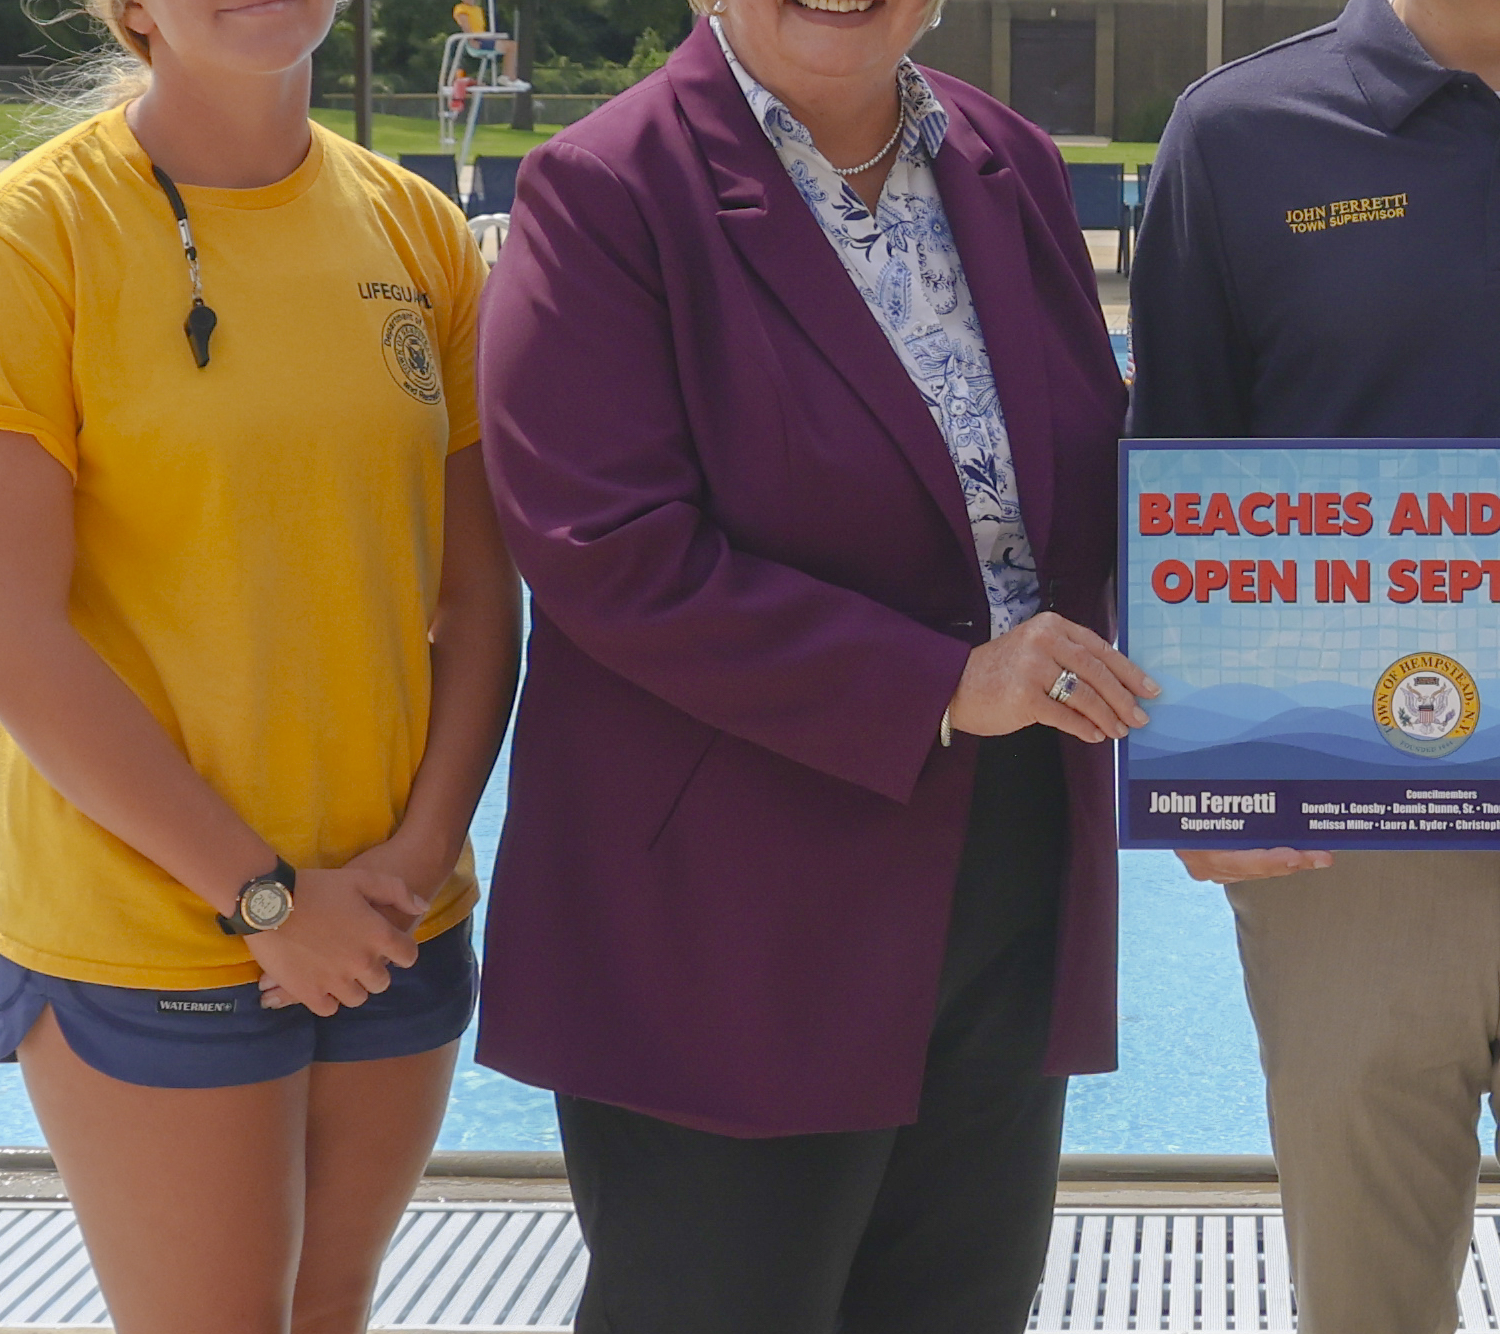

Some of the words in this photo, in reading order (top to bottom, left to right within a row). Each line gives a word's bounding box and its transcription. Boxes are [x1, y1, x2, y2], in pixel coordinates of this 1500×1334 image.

[1285, 205, 1326, 223] JOHN
[1329, 192, 1408, 216] FERRETTI
[1289, 219, 1326, 234] TOWN
[1329, 207, 1405, 227] SUPERVISOR
[1138, 492, 1373, 537] BEACHES
[1151, 560, 1298, 604] OPEN
[1314, 560, 1371, 604] IN
[1382, 670, 1398, 689] OF
[1377, 692, 1394, 735] TOWN
[1149, 791, 1197, 813] John
[1200, 791, 1276, 813] Ferretti
[1406, 789, 1478, 799] Councilmembers
[1301, 802, 1340, 815] Dorothy
[1341, 803, 1349, 814] L.
[1350, 802, 1386, 815] Goosby
[1392, 802, 1427, 814] Dennis
[1428, 803, 1461, 815] Dunne,
[1462, 803, 1475, 814] Sr.
[1180, 816, 1245, 831] Supervisor
[1309, 819, 1346, 830] Melissa
[1346, 819, 1374, 830] Miller
[1380, 819, 1407, 830] Laura
[1408, 819, 1418, 830] A.
[1419, 819, 1448, 831] Ryder
[160, 1000, 223, 1012] WATERMEN
